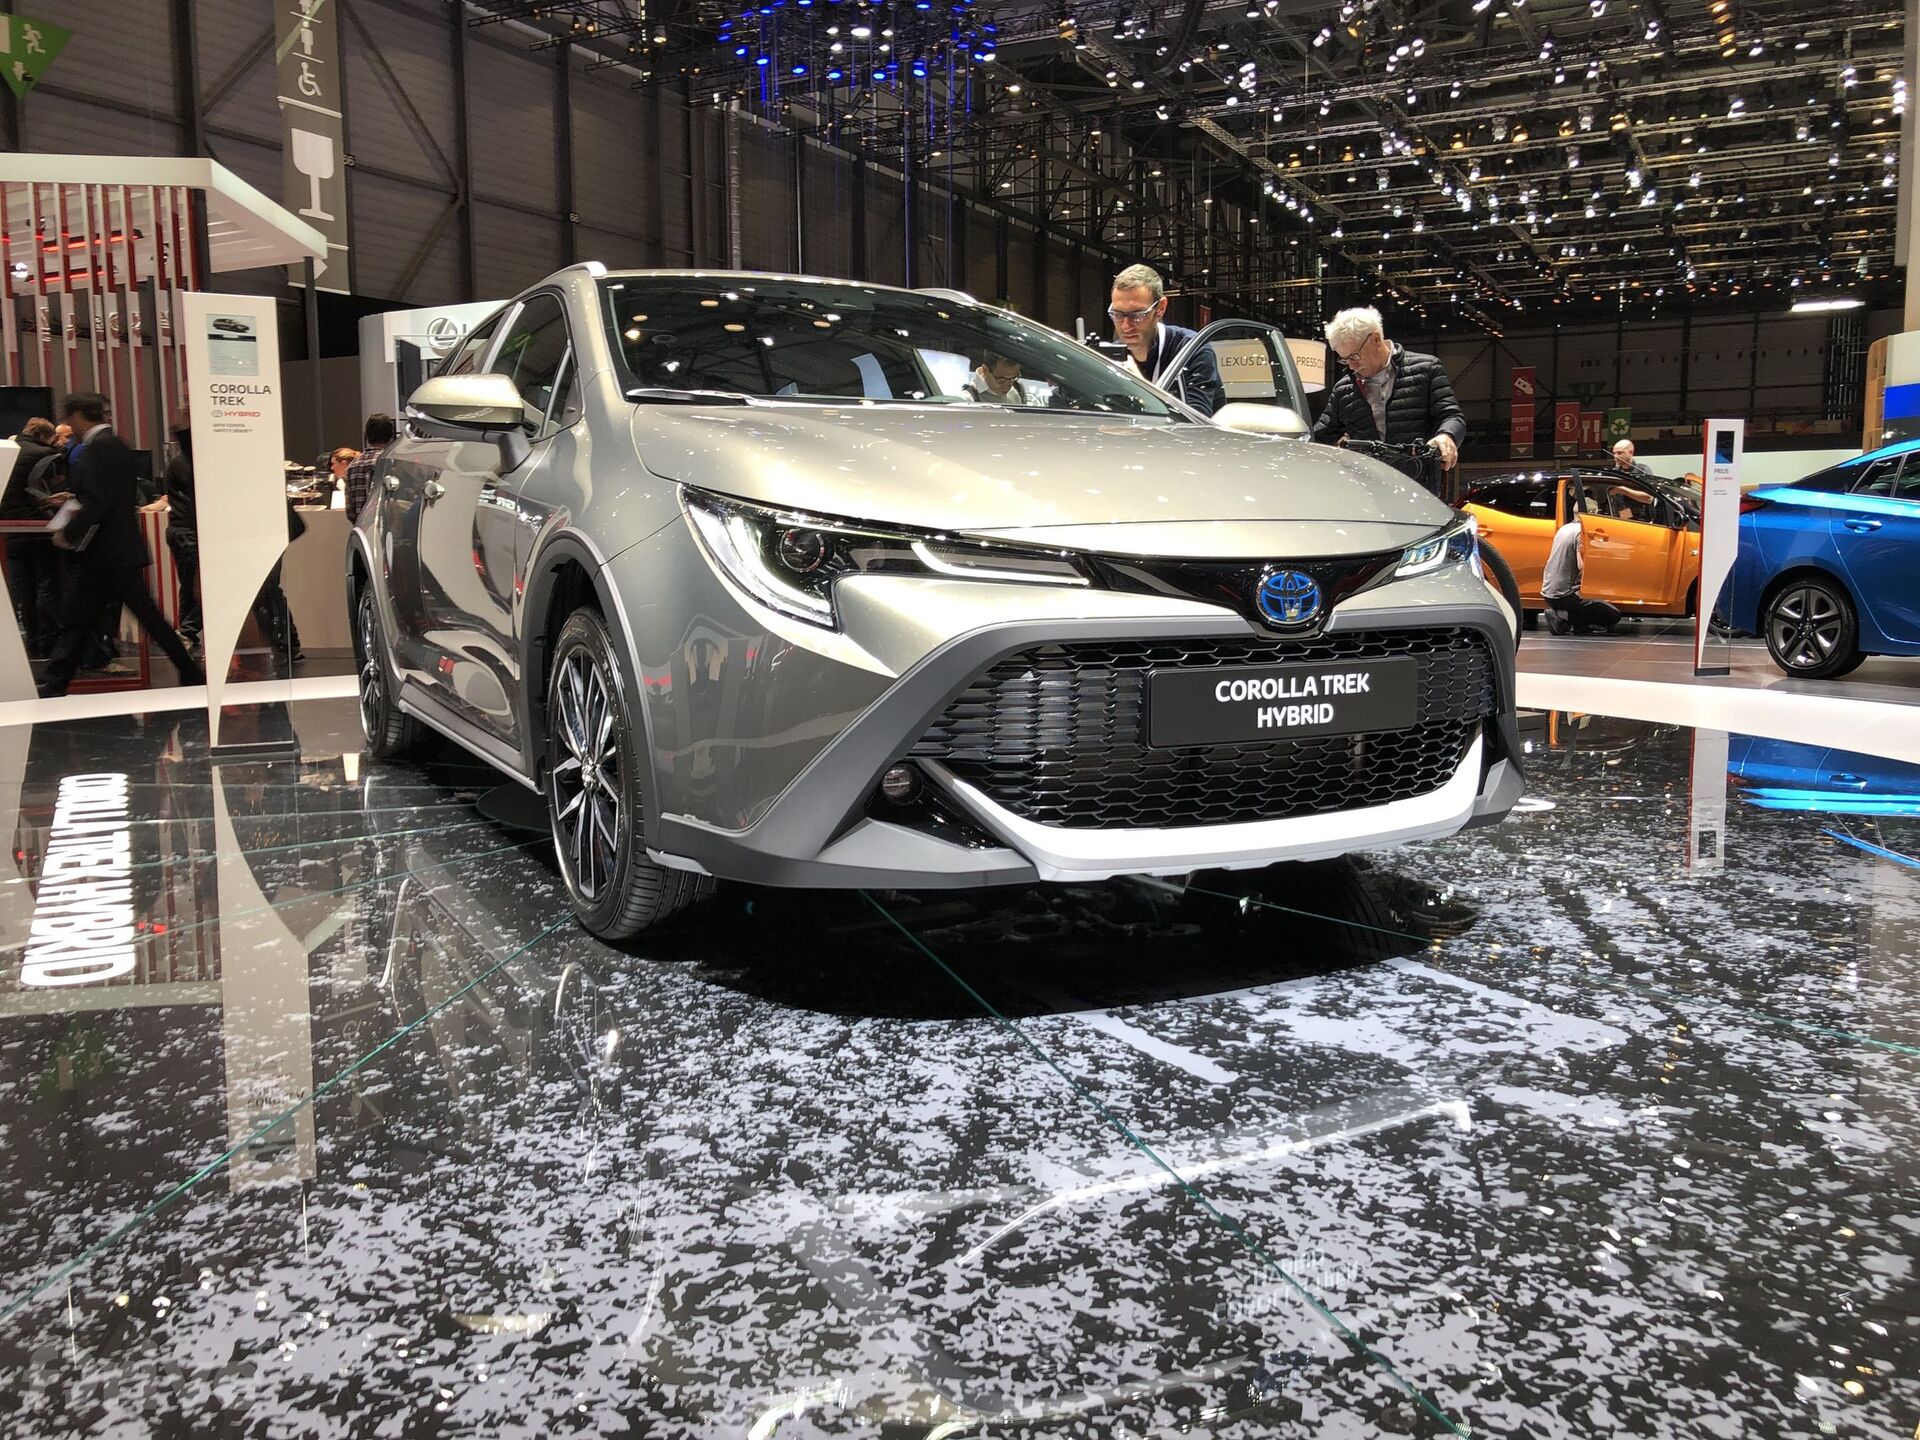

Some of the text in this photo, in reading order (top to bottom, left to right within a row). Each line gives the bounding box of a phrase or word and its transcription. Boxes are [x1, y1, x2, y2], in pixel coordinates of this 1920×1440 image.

[1221, 356, 1254, 367] LEXUS
[1296, 356, 1316, 367] PRESS
[210, 384, 272, 395] COROLLA
[210, 396, 246, 406] TREK
[1215, 672, 1370, 702] COROLLA TREK
[1257, 703, 1334, 728] HYBRID
[39, 831, 132, 884] TREK
[21, 879, 136, 986] HYBRID
